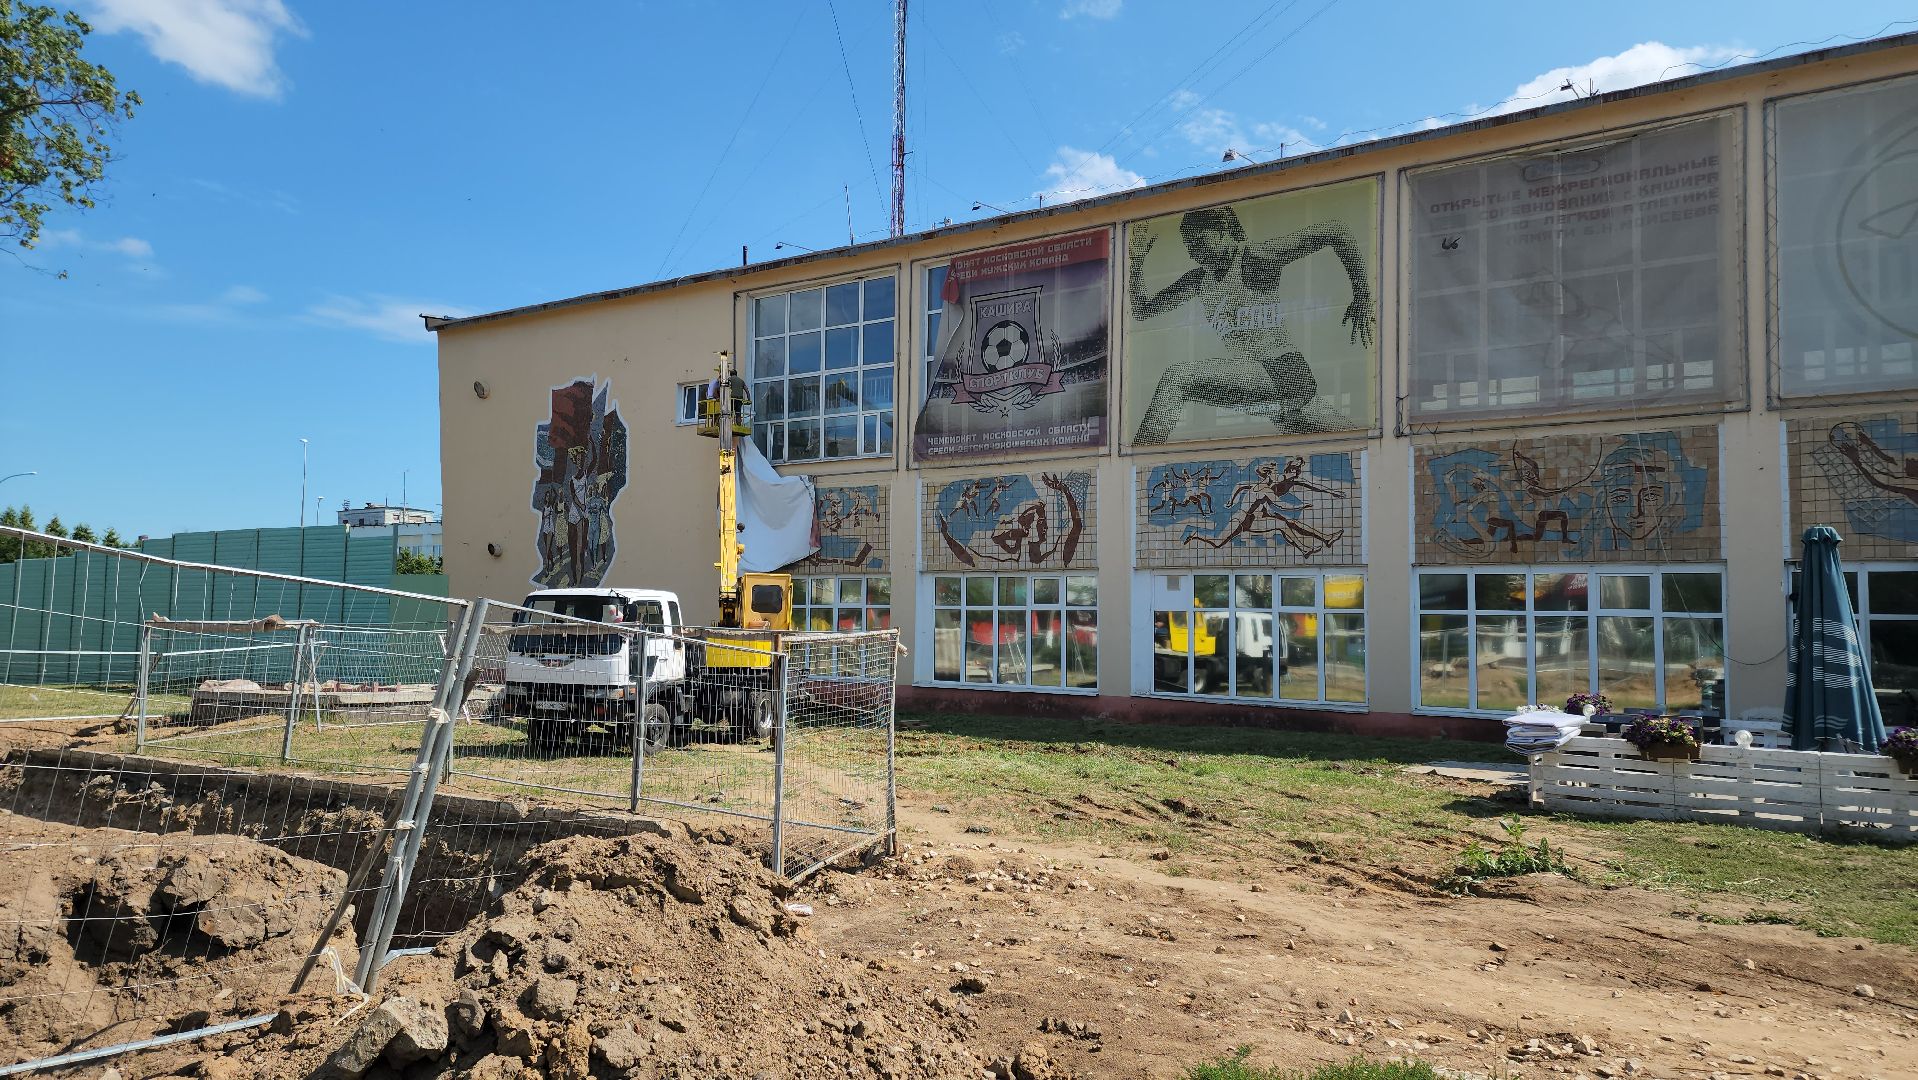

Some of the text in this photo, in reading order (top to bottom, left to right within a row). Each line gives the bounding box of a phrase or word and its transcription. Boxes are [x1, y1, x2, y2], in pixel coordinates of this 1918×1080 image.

[1430, 190, 1520, 214] ОТКРЫТЫЕ
[1528, 155, 1719, 198] МЕЖРЕГИОНАЛЬНЫЕ
[983, 247, 1044, 265] МОСКОВСКОЙ
[1047, 238, 1092, 253] ОБЛАСТИ
[981, 262, 1028, 276] МУЖСКИХ
[1029, 254, 1069, 269] КОМАНД
[979, 301, 1033, 319] КАШИРА
[969, 368, 1044, 389] СПОРТКЛУБ
[928, 422, 1090, 446] ЧЕМПИОНАТ МОСКОВСКОЙ ОБЛАСТИ
[1052, 434, 1090, 446] КОМАНД
